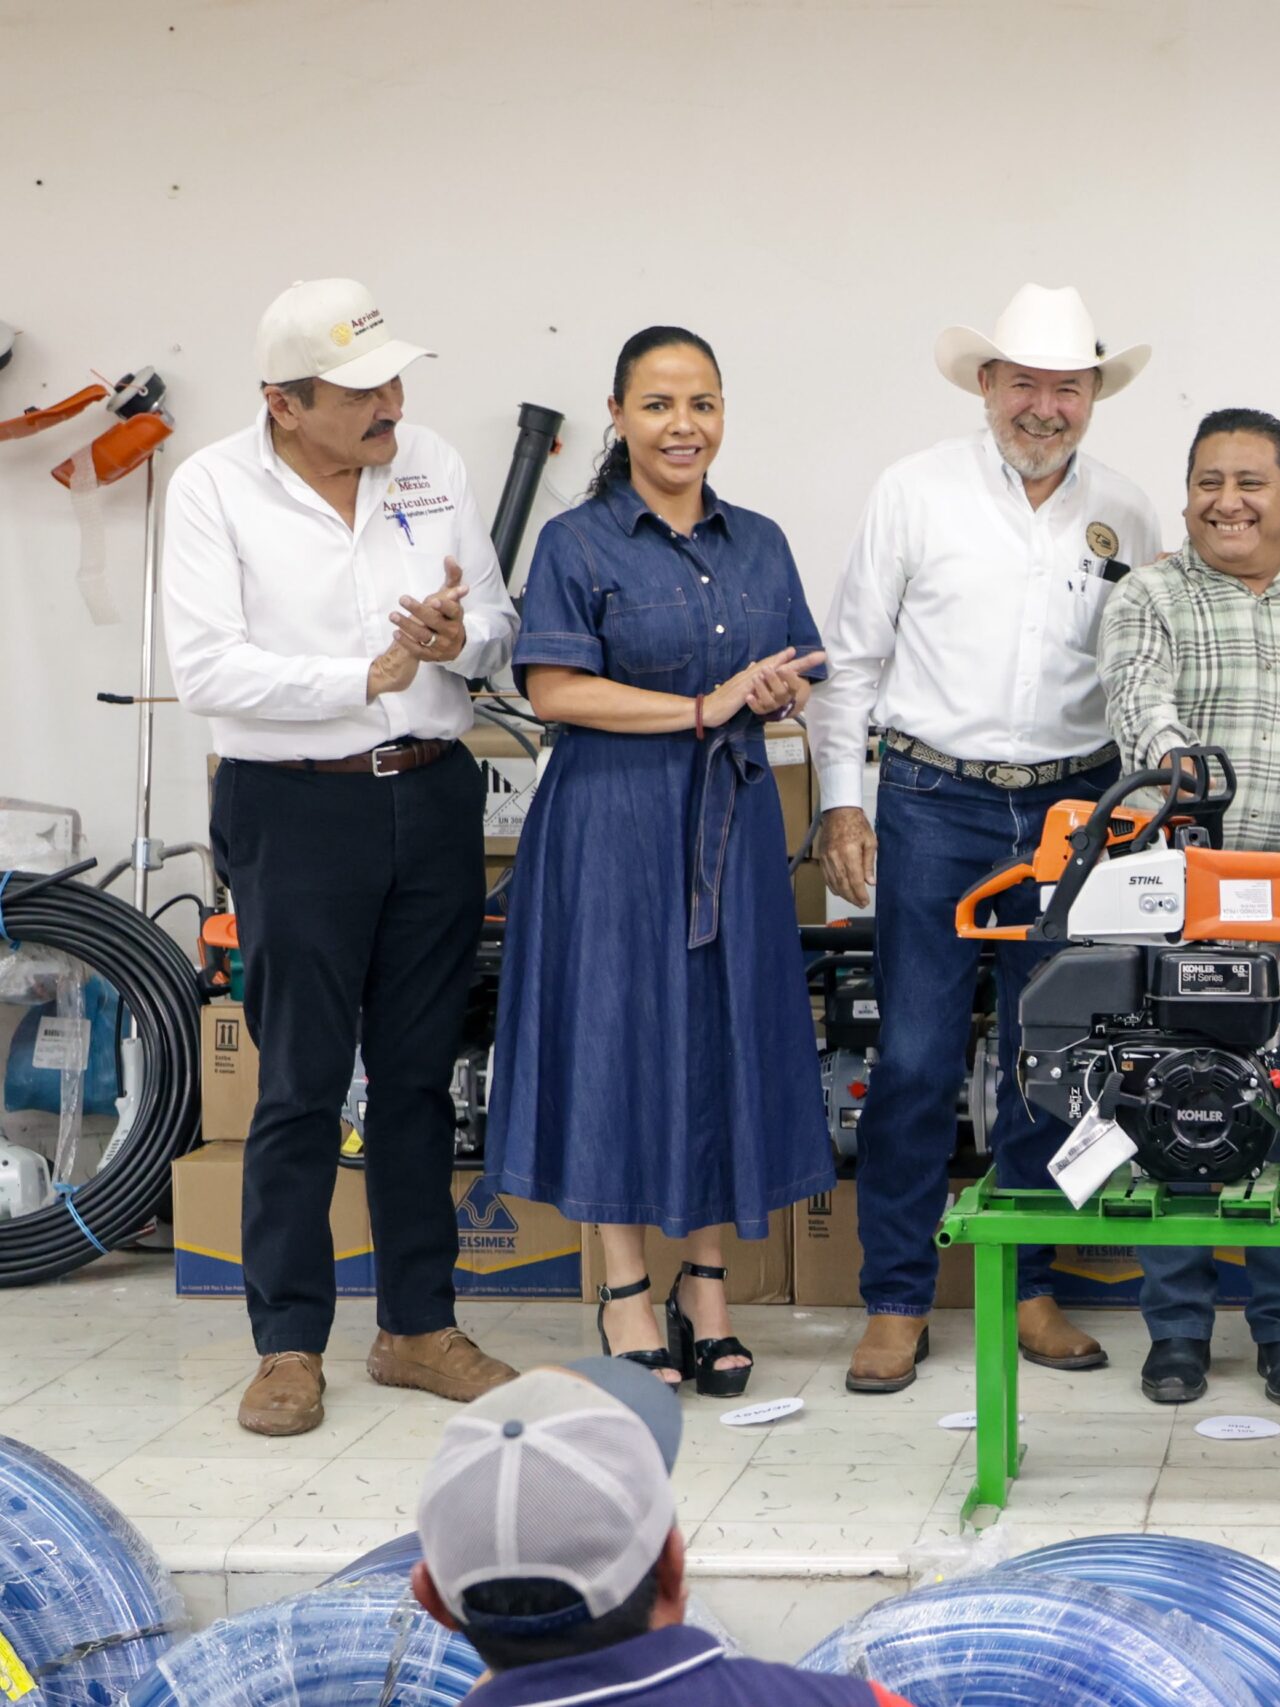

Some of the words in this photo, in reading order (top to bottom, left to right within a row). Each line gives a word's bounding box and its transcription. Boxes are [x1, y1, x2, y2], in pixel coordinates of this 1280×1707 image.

[383, 495, 448, 512] Agricultura
[1129, 876, 1163, 885] STIHL
[1182, 965, 1215, 973] KOHLER
[1182, 973, 1196, 981] SH
[1198, 973, 1223, 982] Series
[1177, 1110, 1223, 1122] KOHLER
[459, 1236, 515, 1248] ELSIMEX
